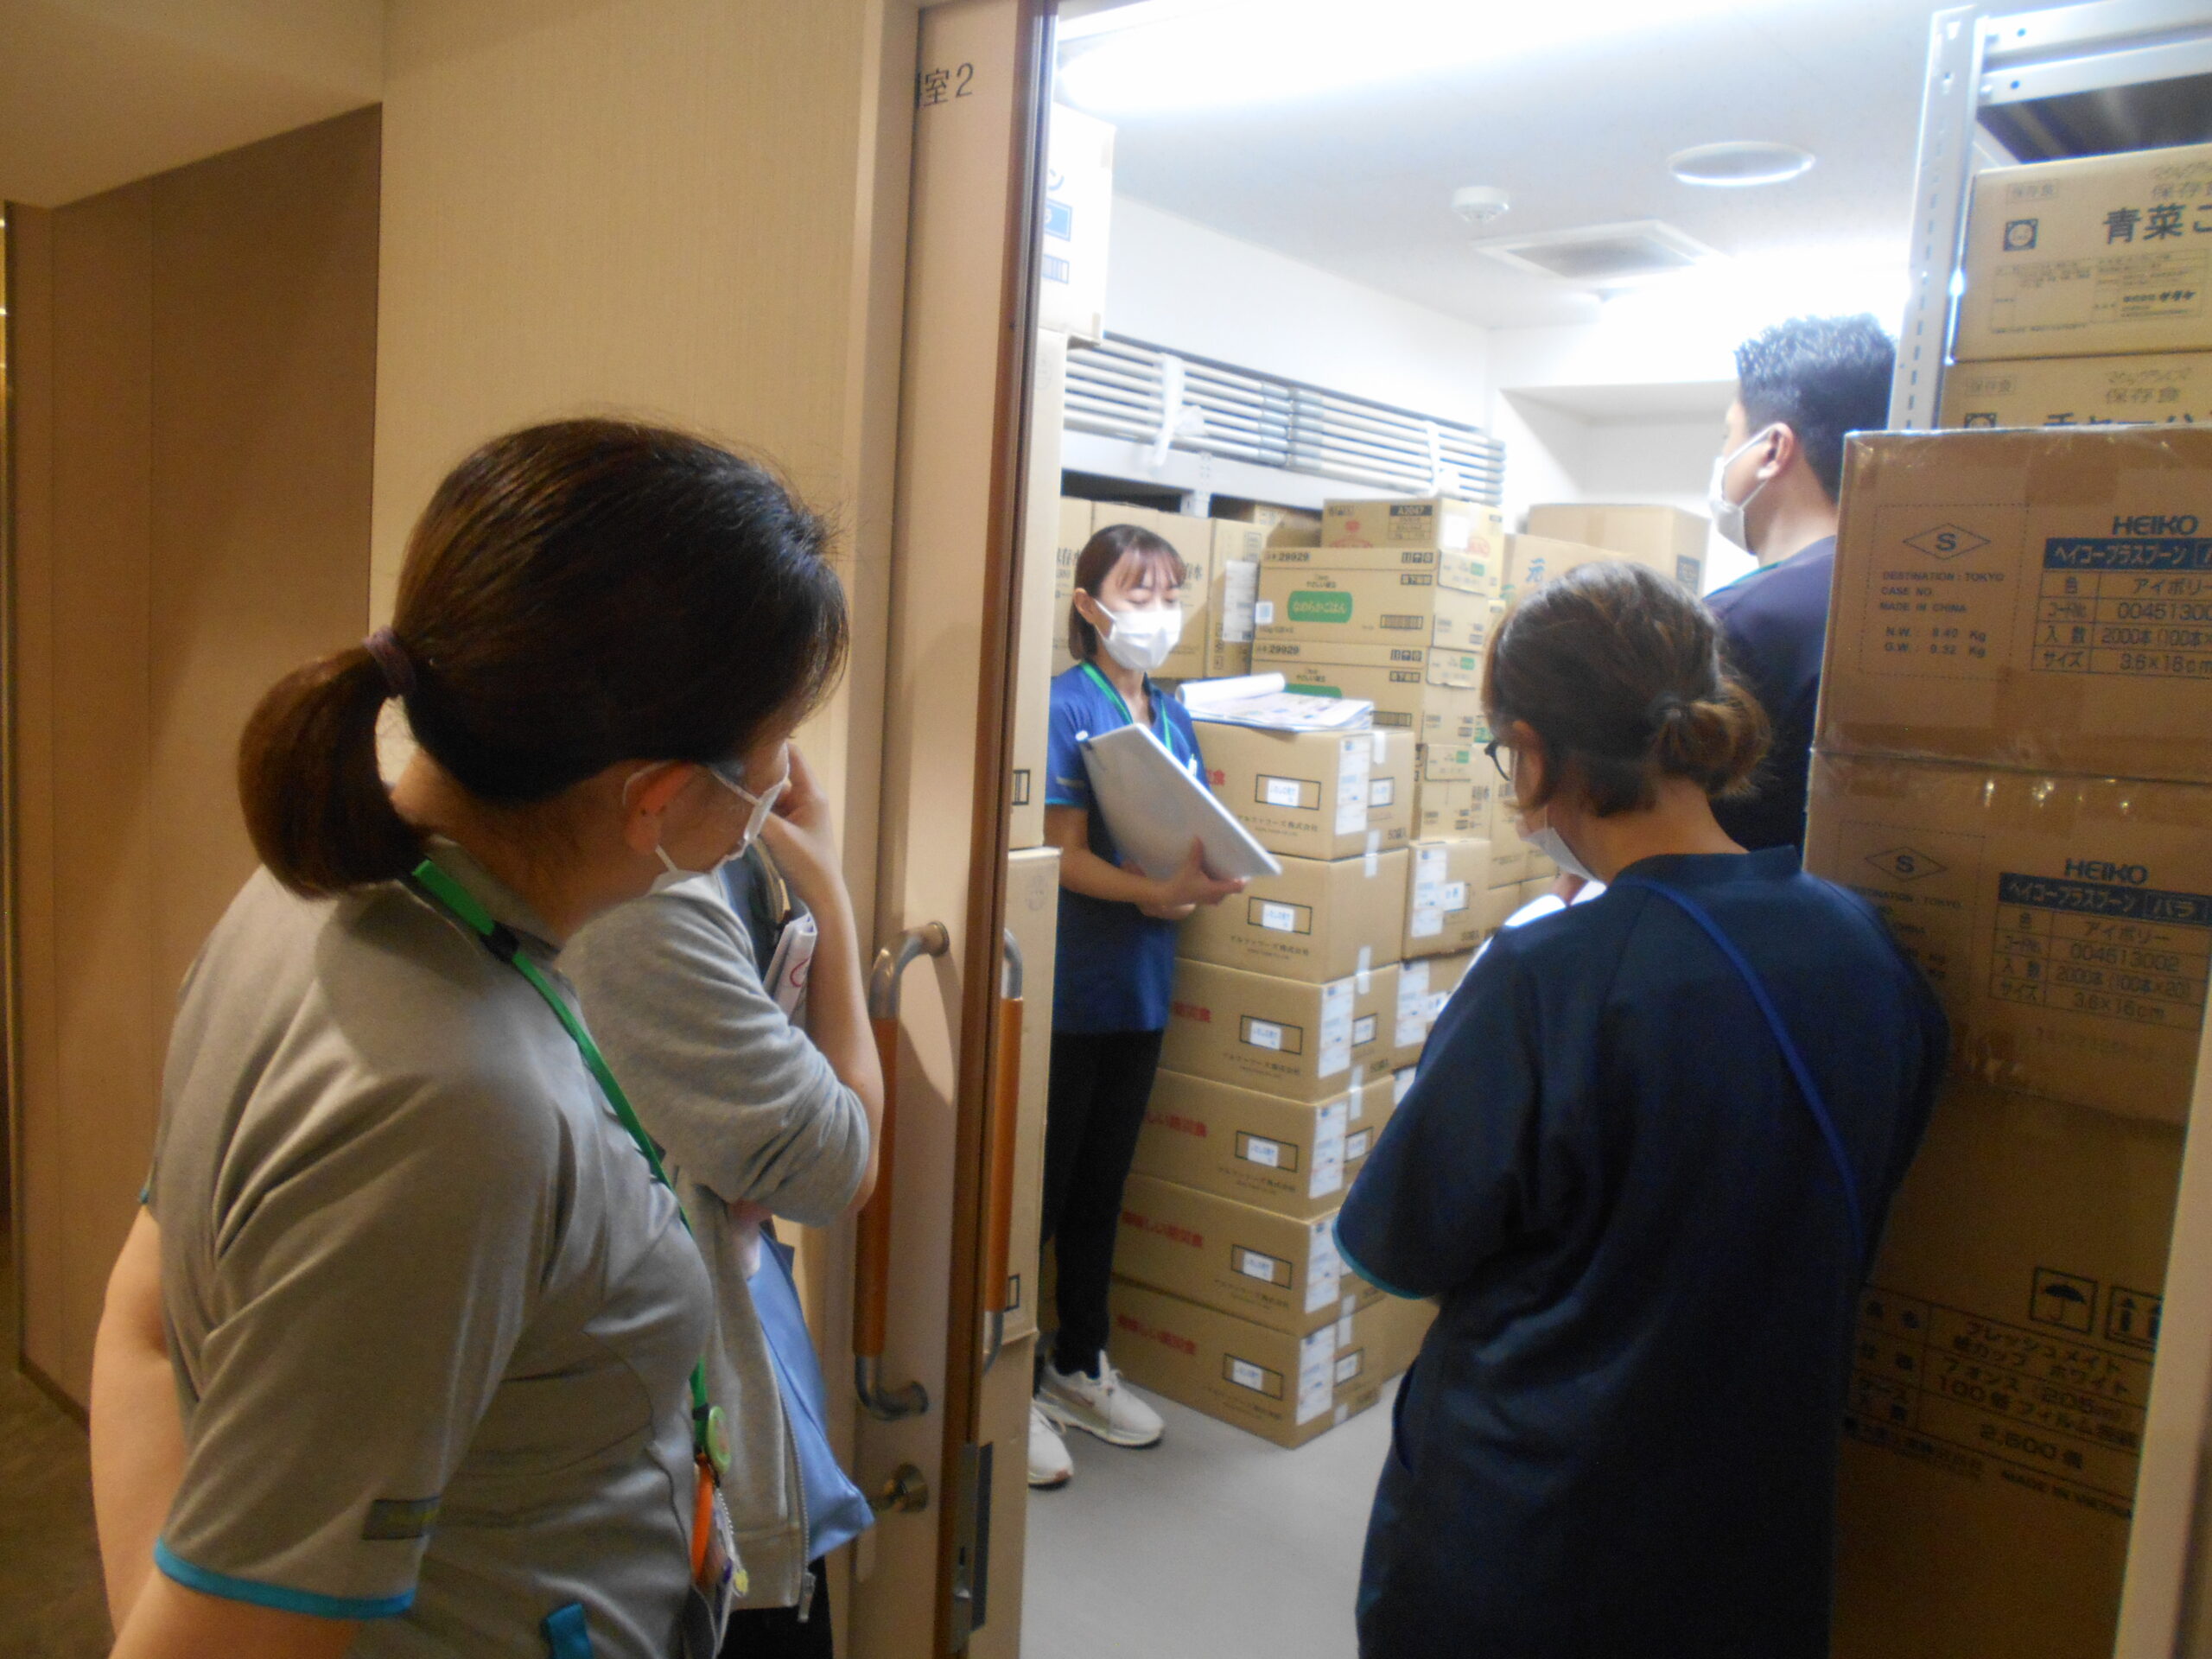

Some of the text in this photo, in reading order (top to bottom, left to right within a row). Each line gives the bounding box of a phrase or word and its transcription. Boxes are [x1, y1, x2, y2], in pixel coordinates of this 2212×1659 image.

[918, 62, 974, 108] 室2
[2112, 514, 2199, 536] HEIKO
[1935, 531, 1957, 551] S
[1965, 572, 2005, 582] TOKYO
[1881, 586, 1910, 596] CASE
[1879, 602, 1967, 613] MADE IN CHINA
[1895, 854, 1915, 874] S
[2064, 858, 2148, 885] HEIKO
[1923, 896, 1961, 910] TOKYO
[2152, 899, 2196, 918] バラ
[2083, 921, 2171, 945] アイボリー
[2069, 943, 2181, 972] 004513002
